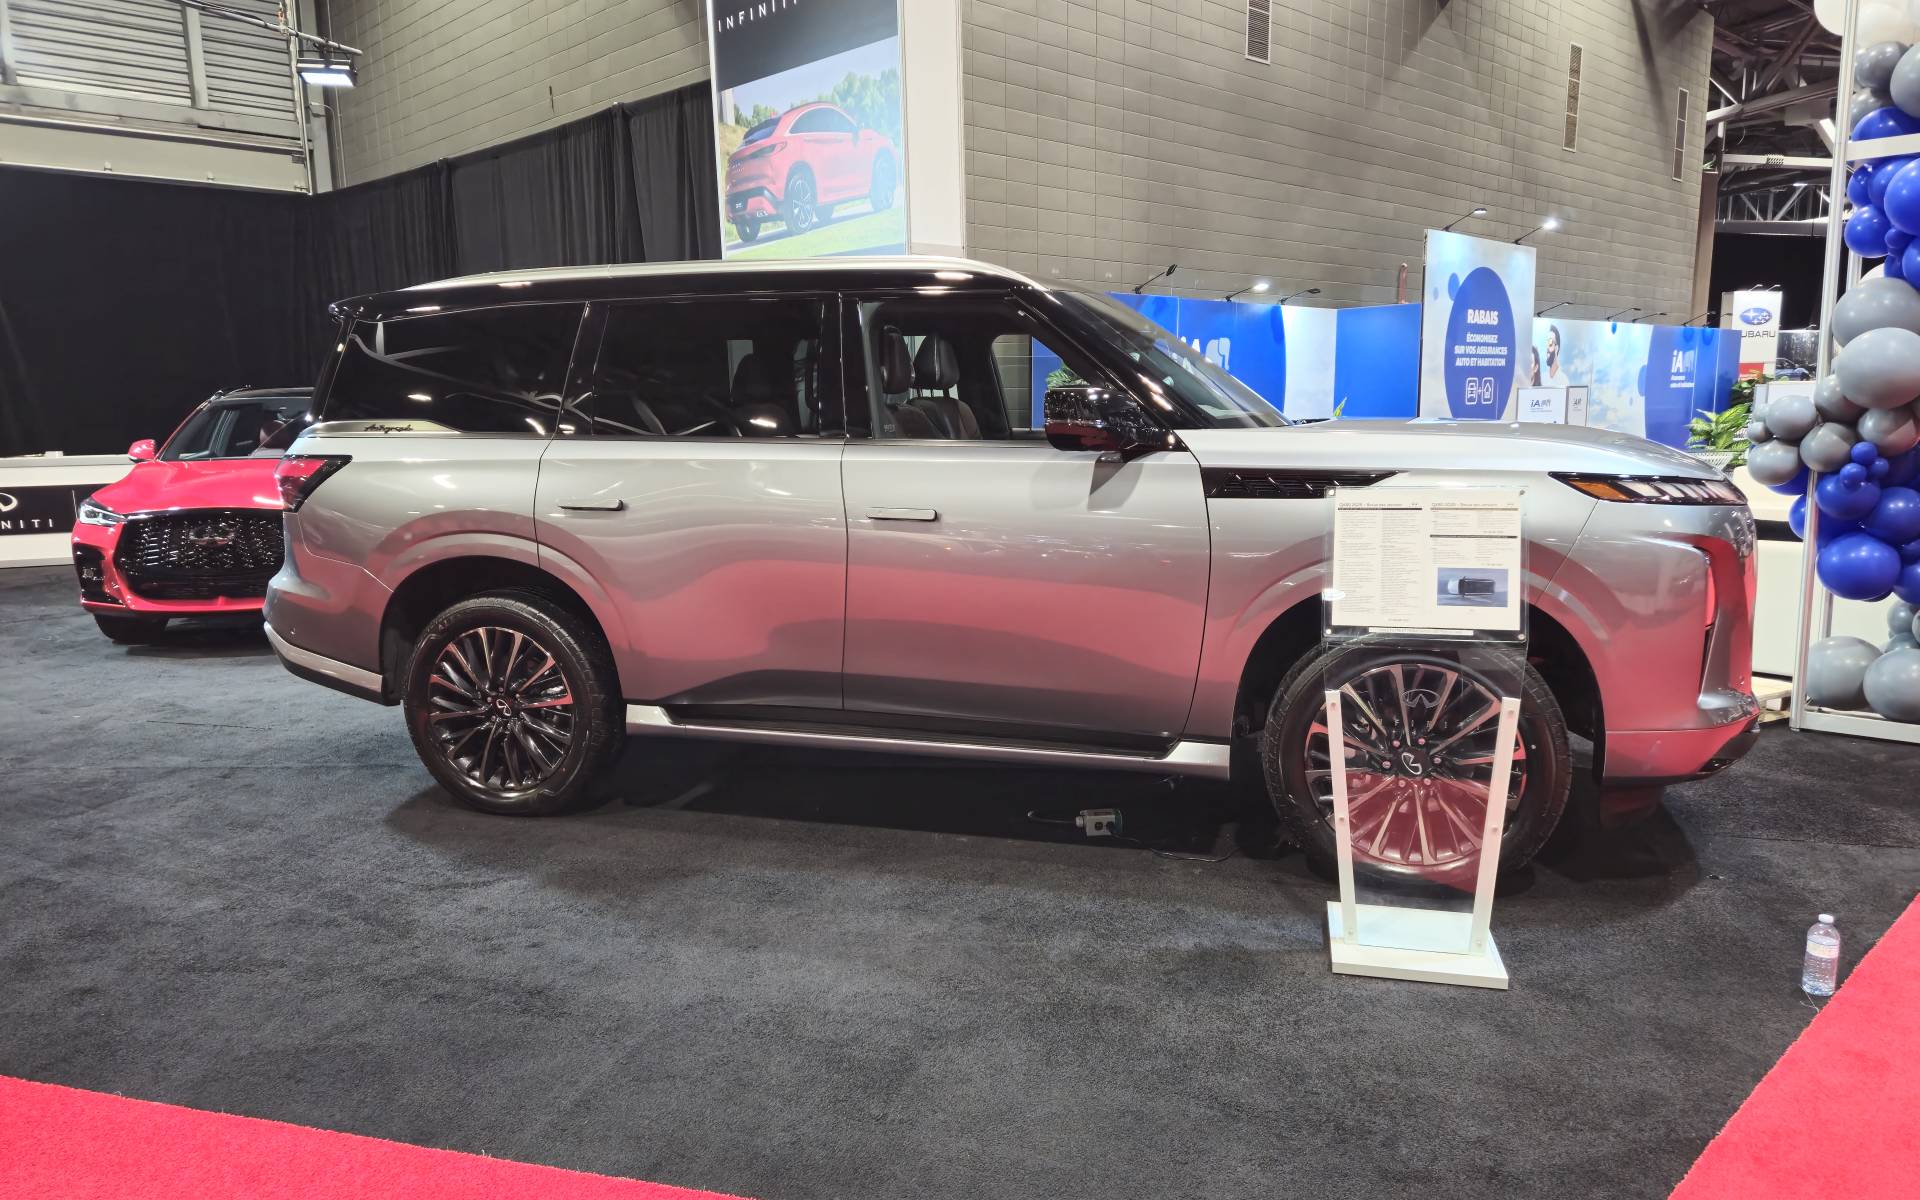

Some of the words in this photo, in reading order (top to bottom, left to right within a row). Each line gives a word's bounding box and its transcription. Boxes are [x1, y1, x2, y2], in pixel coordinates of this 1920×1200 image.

[718, 0, 798, 33] INFINI
[1467, 309, 1499, 325] RABAIS
[1466, 332, 1498, 343] ÉCONOMISEZ
[1741, 330, 1776, 338] UBARU
[1454, 345, 1466, 354] SUR
[1466, 346, 1477, 354] VOS
[1477, 346, 1508, 355] ASSURANCES
[1455, 356, 1470, 366] AUTO
[1470, 357, 1478, 366] ET
[1477, 357, 1506, 367] HABITATION
[1, 518, 53, 530] NITI
